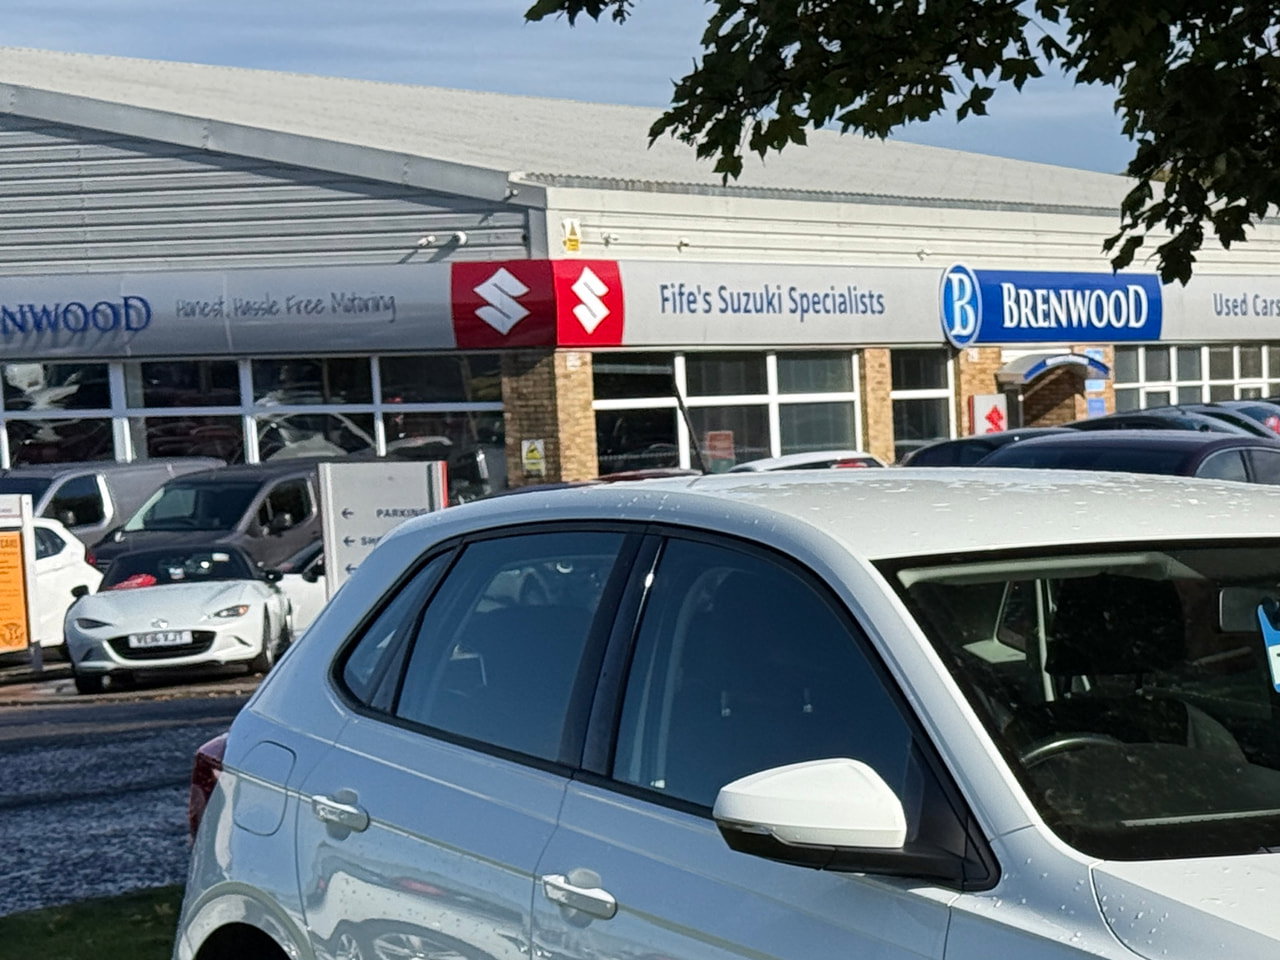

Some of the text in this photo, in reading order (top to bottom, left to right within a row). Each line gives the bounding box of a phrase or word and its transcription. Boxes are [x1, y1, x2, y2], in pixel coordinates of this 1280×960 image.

[233, 292, 281, 318] Hassle
[286, 295, 326, 315] Free
[331, 291, 396, 324] Motoring
[659, 283, 886, 323] Fife's Suzuki Specialists
[1001, 282, 1149, 329] BRENWOOD
[1213, 292, 1248, 317] Used
